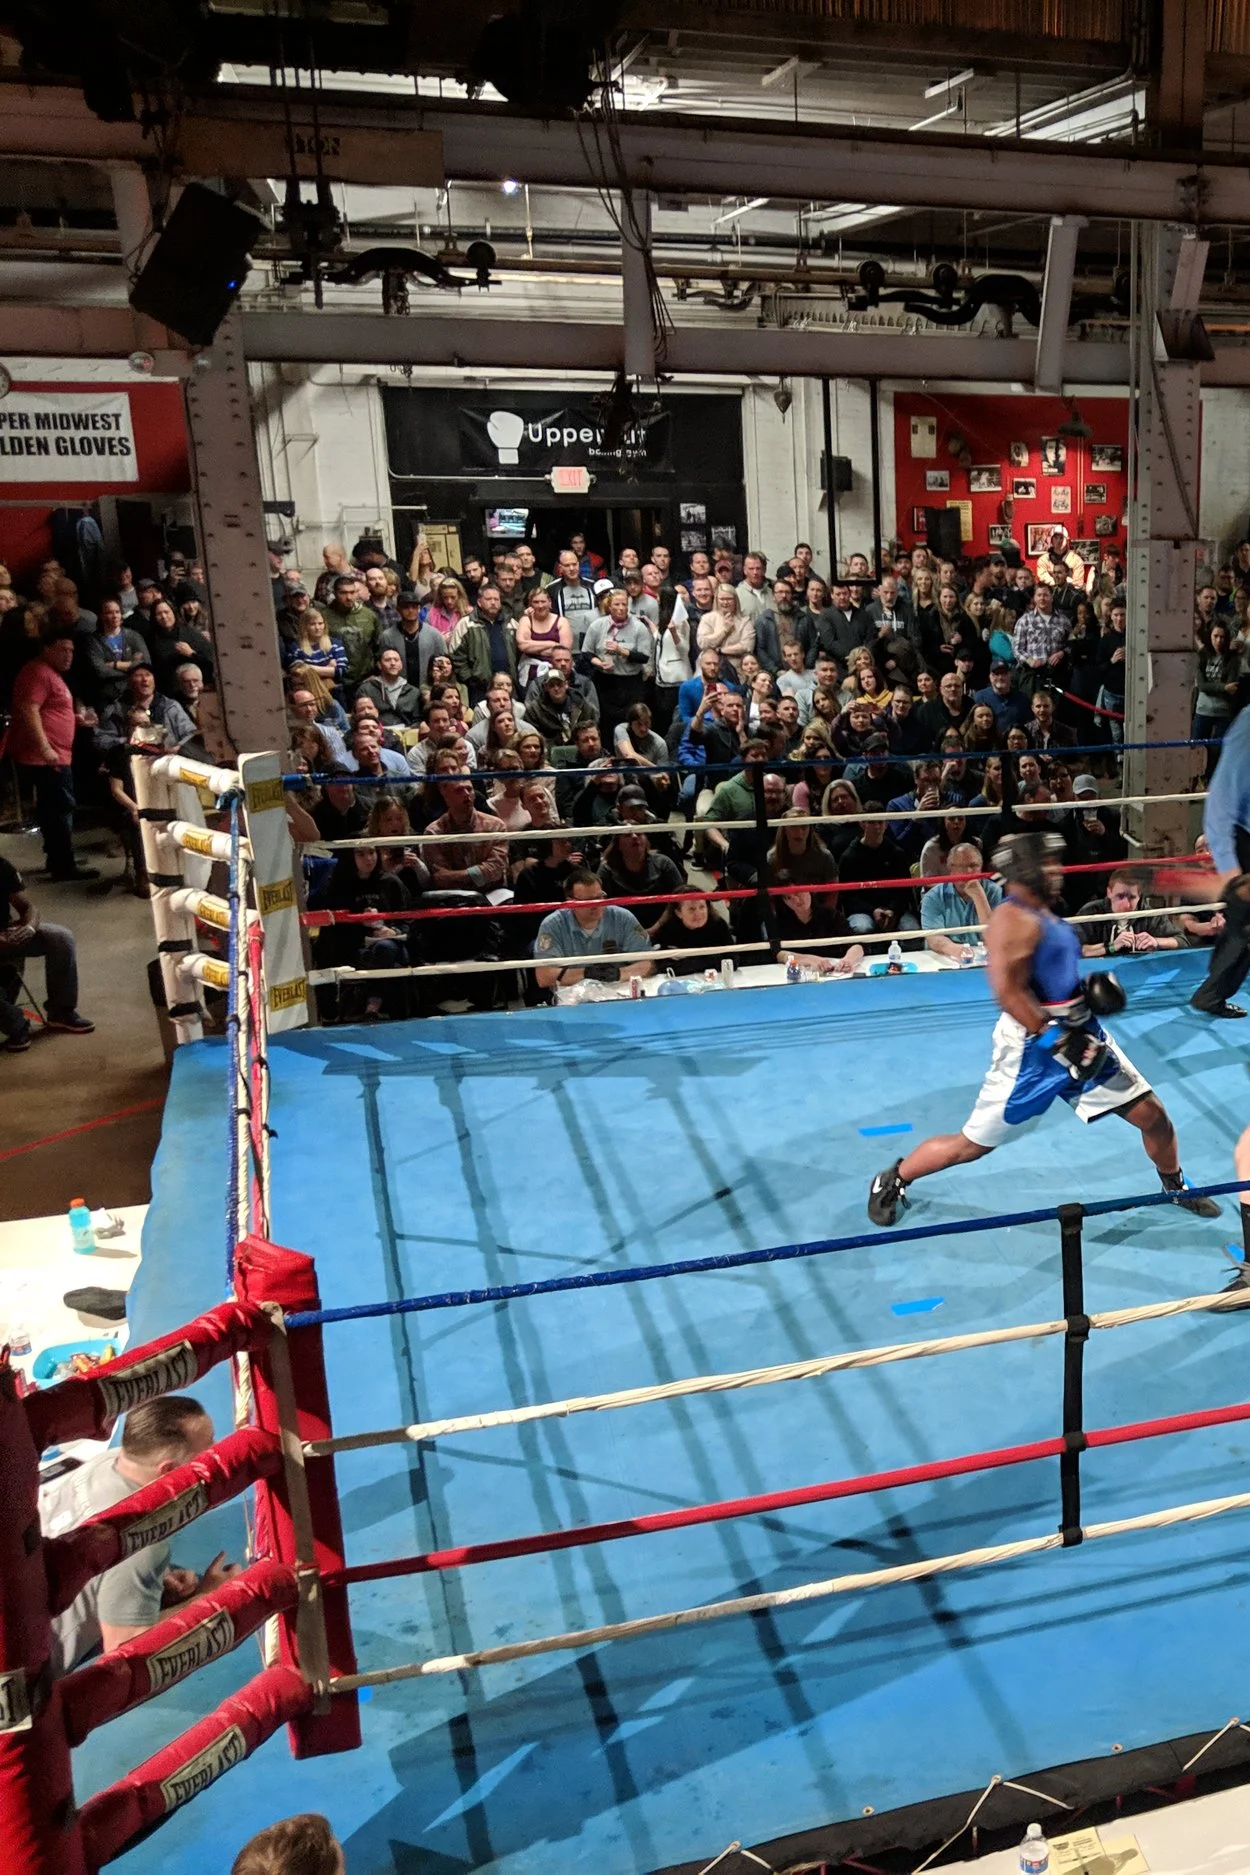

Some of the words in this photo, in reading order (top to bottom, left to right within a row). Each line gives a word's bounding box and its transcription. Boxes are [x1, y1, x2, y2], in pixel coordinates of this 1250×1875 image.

[0, 412, 31, 430] PER
[34, 412, 121, 431] MIDWEST
[0, 436, 50, 456] LDEN
[55, 436, 131, 456] GLOVES
[558, 469, 583, 487] EXIT
[263, 881, 294, 910] EVERLAST
[274, 981, 305, 1005] EVERLAST
[109, 1346, 189, 1412] EVERLAST
[127, 1490, 200, 1551] EVERLAST
[155, 1614, 228, 1684] EVERLAST
[169, 1732, 239, 1805] EVERLAST
